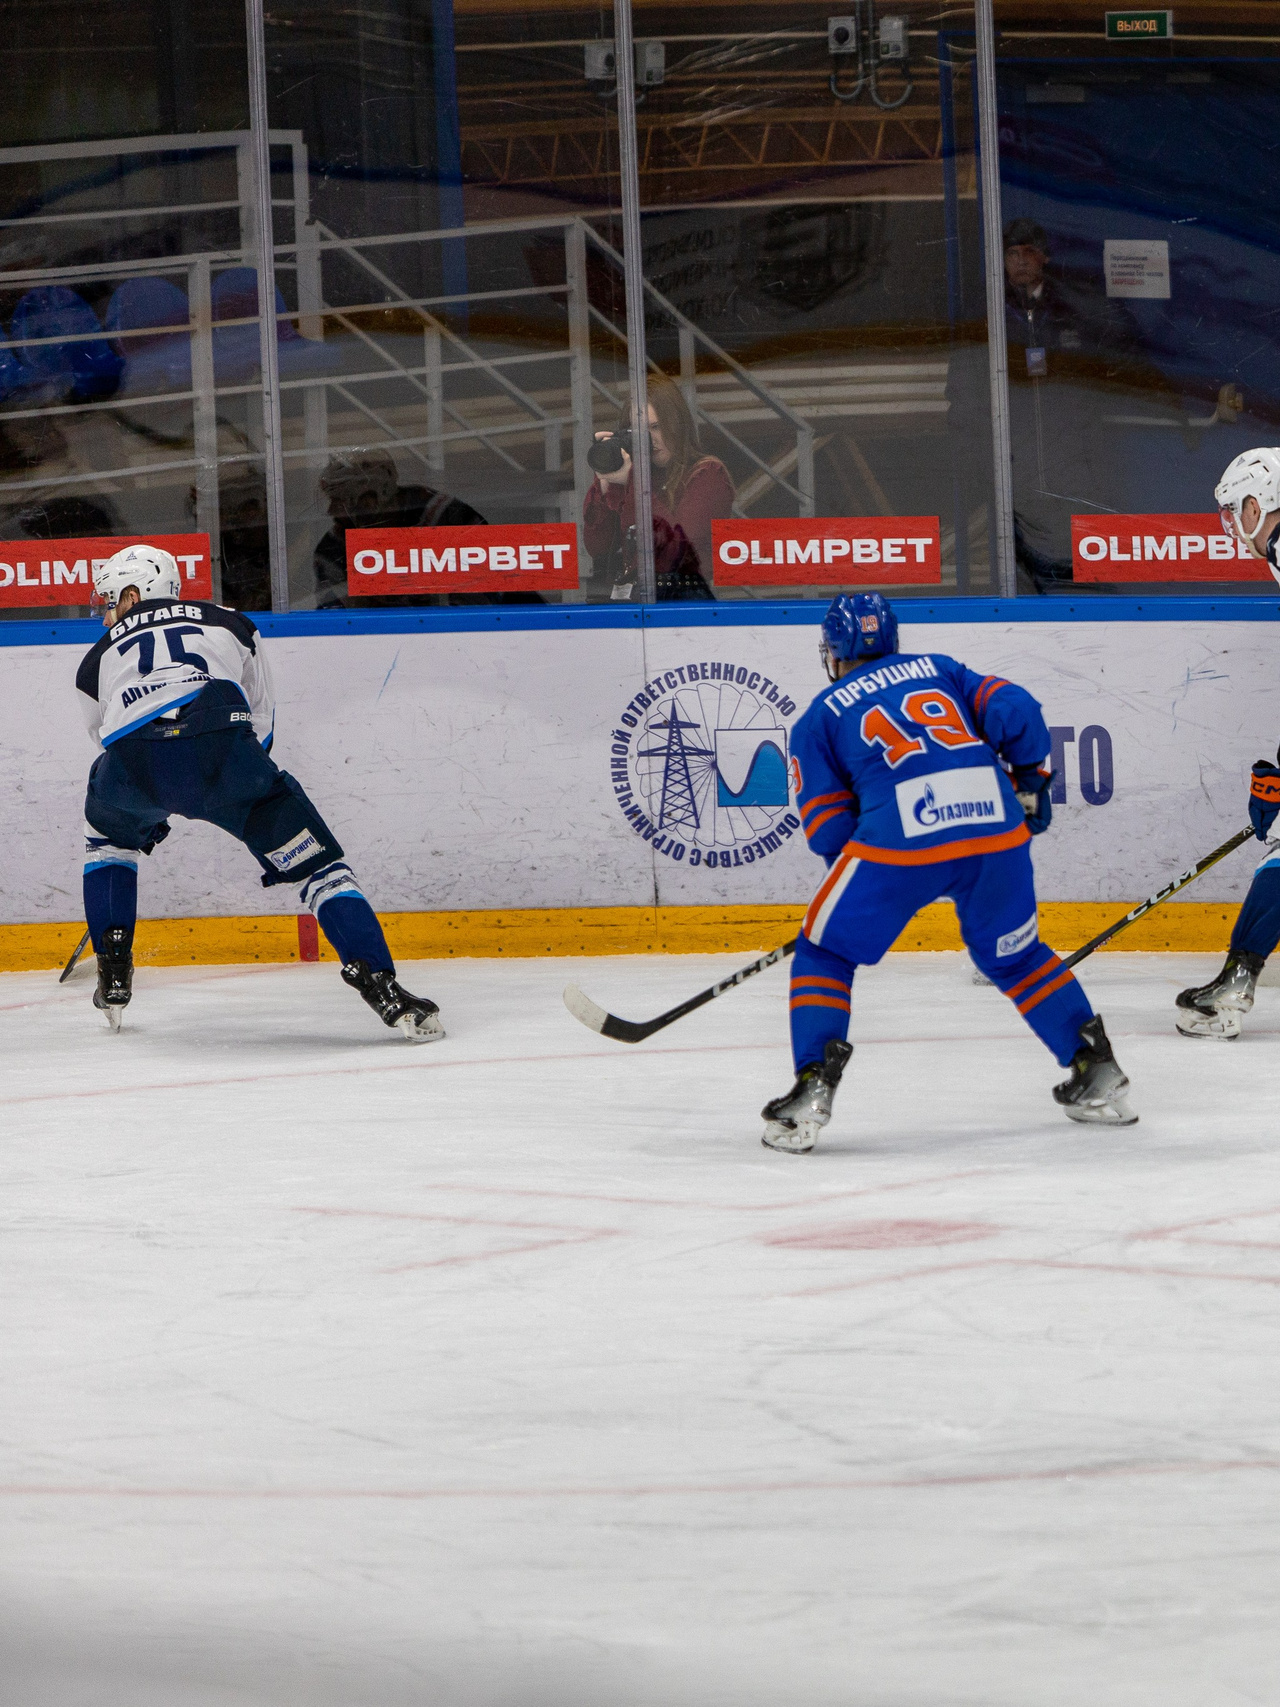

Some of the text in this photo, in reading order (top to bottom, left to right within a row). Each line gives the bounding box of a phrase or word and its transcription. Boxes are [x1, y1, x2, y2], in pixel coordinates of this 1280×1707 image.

[1116, 19, 1158, 33] ВЫХОД
[353, 544, 571, 575] OLIMPBET
[719, 537, 933, 565] OLIMPBET
[110, 604, 203, 641] БУГАЕВ
[860, 614, 880, 633] 19
[116, 625, 209, 675] 75
[823, 655, 939, 718] ГОРБУШИН
[860, 688, 985, 771] 19
[610, 661, 801, 869] ОБЩЕСТВО С ОГРАНИЧЕННОЙ ОТВЕТСТВЕННОСТЬЮ
[939, 800, 995, 823] ГАЗПРОМ
[286, 835, 316, 861] БУРЭНЕРГО
[1126, 864, 1198, 921] CCM
[712, 946, 785, 998] CCM
